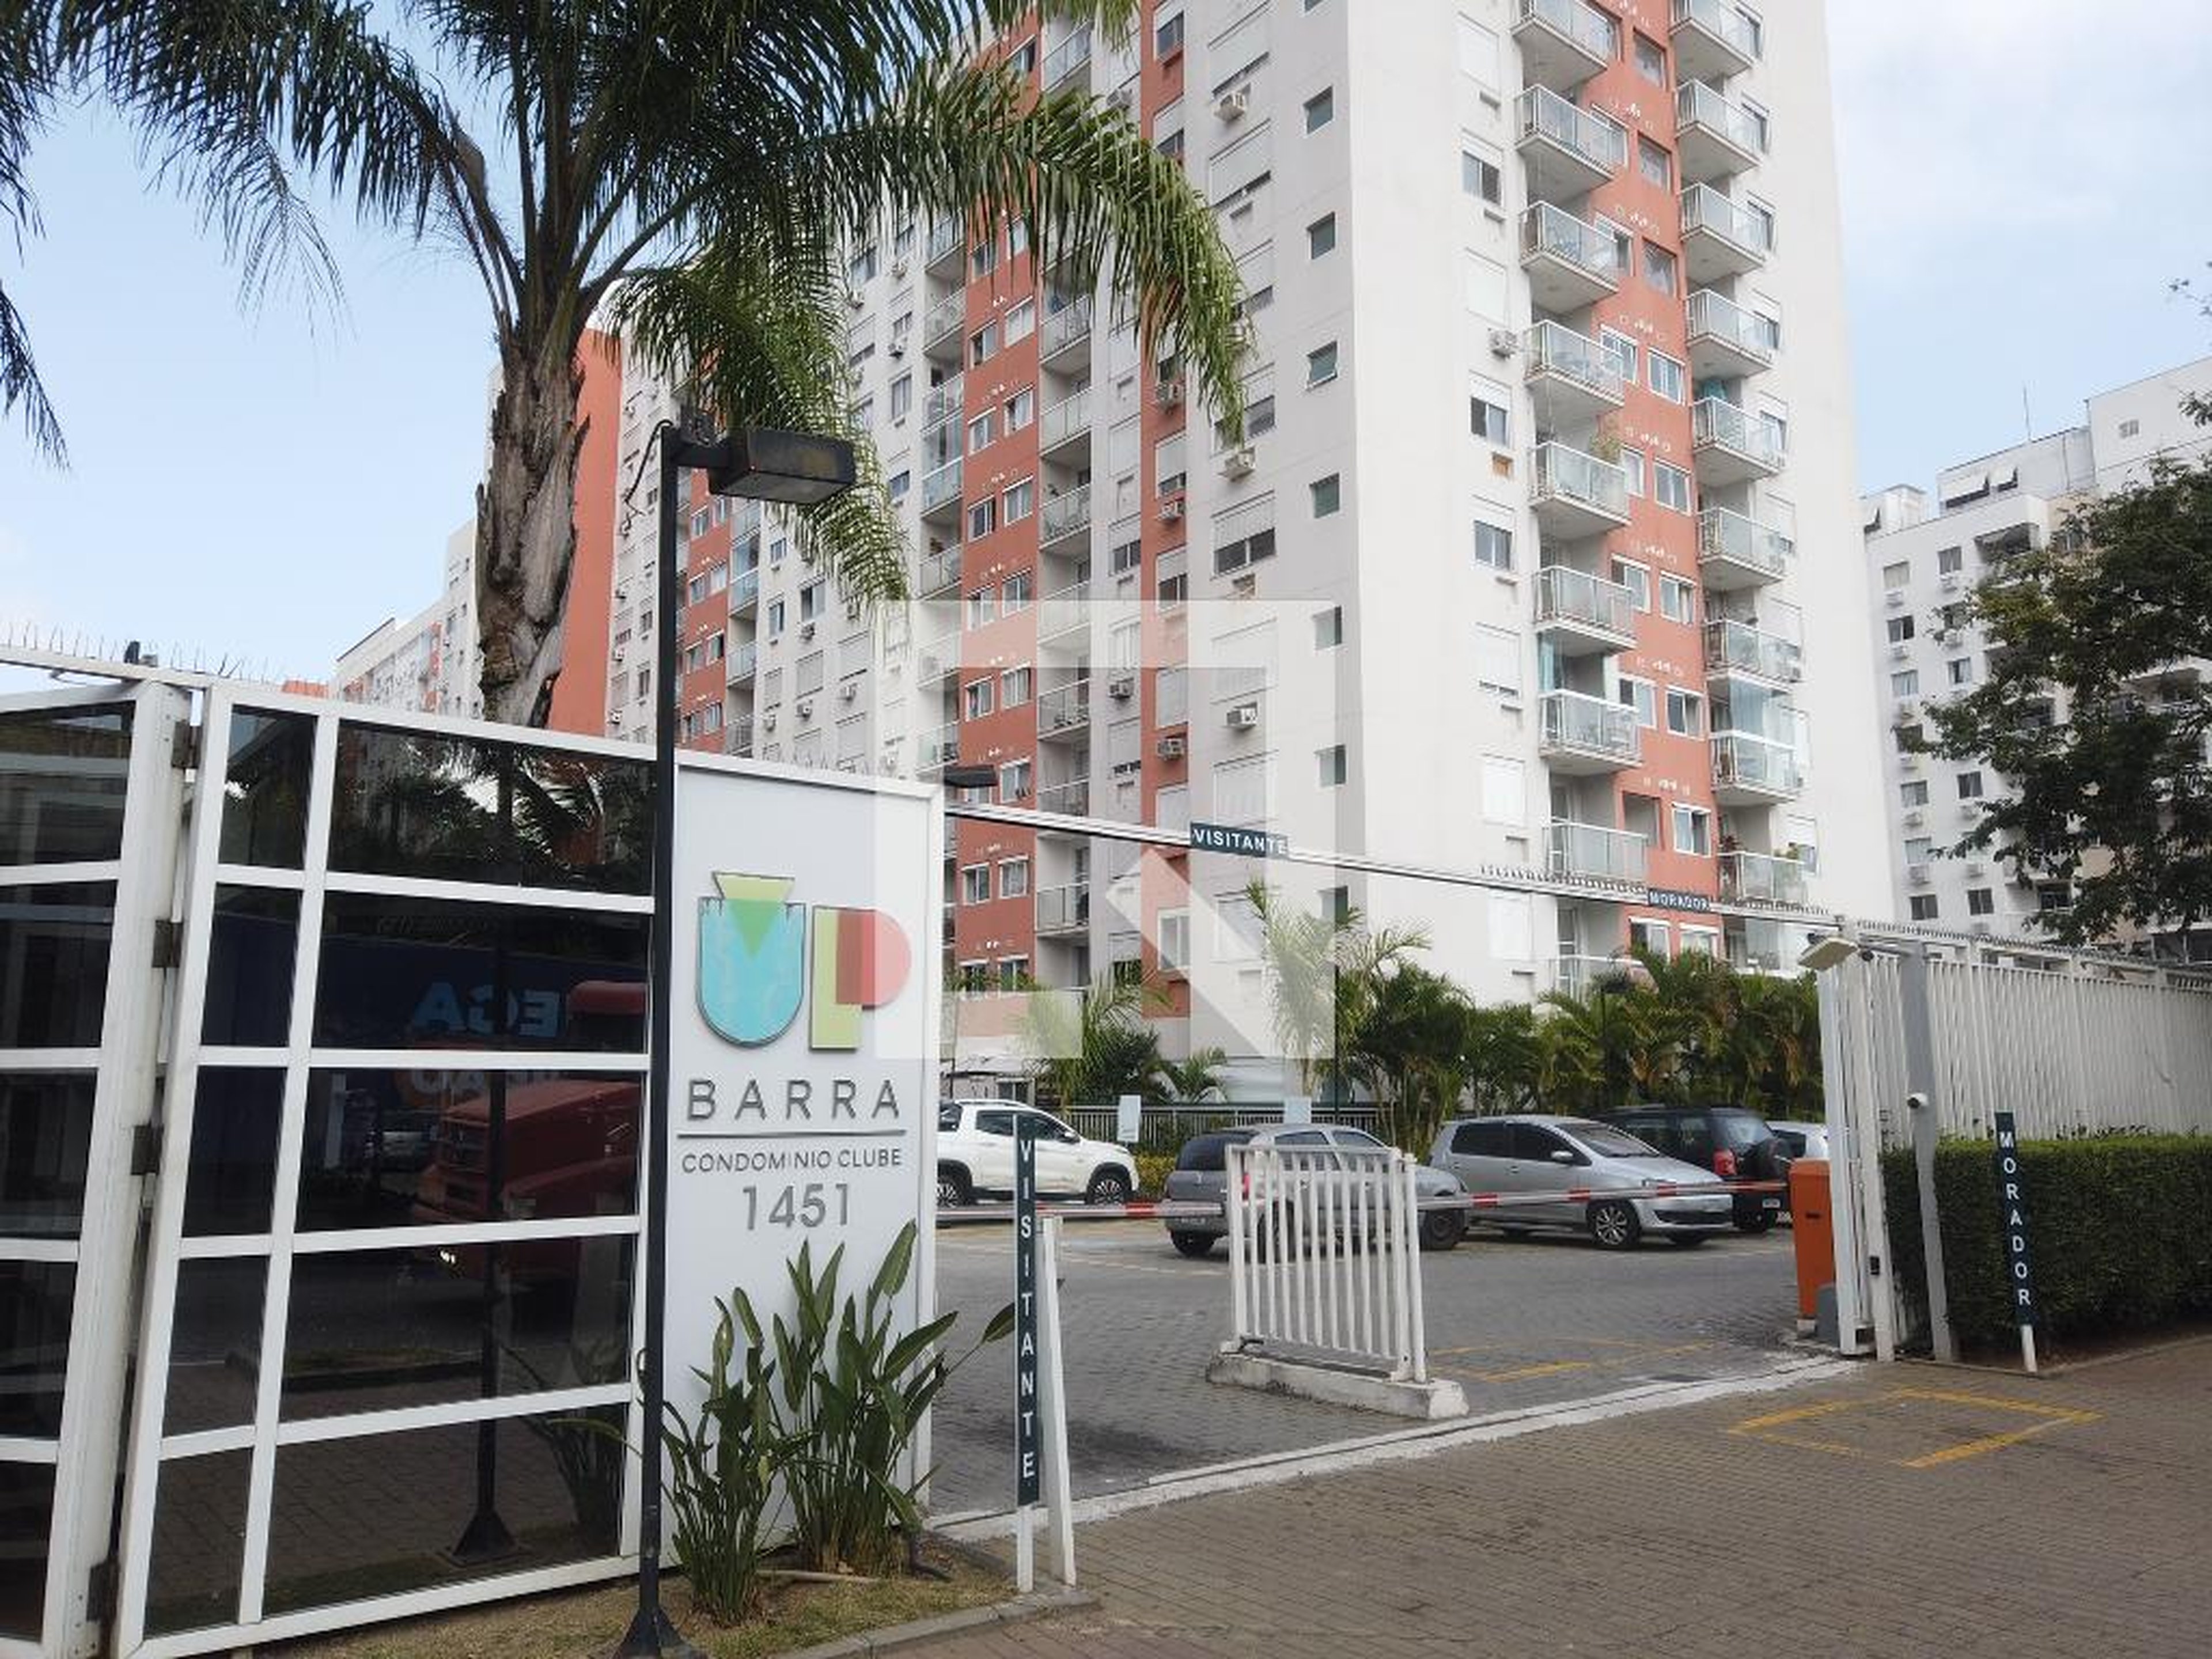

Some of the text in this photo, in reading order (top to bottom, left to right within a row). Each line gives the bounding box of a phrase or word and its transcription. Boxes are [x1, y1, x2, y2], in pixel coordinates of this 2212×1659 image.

[1194, 829, 1288, 855] VISITANTE
[687, 1079, 900, 1121] BARRA
[681, 1148, 902, 1173] CONDOMINIO CLUBE
[743, 1183, 849, 1231] 1451
[1999, 1131, 2031, 1306] MORADOR
[1020, 1139, 1035, 1478] VISITANTE
